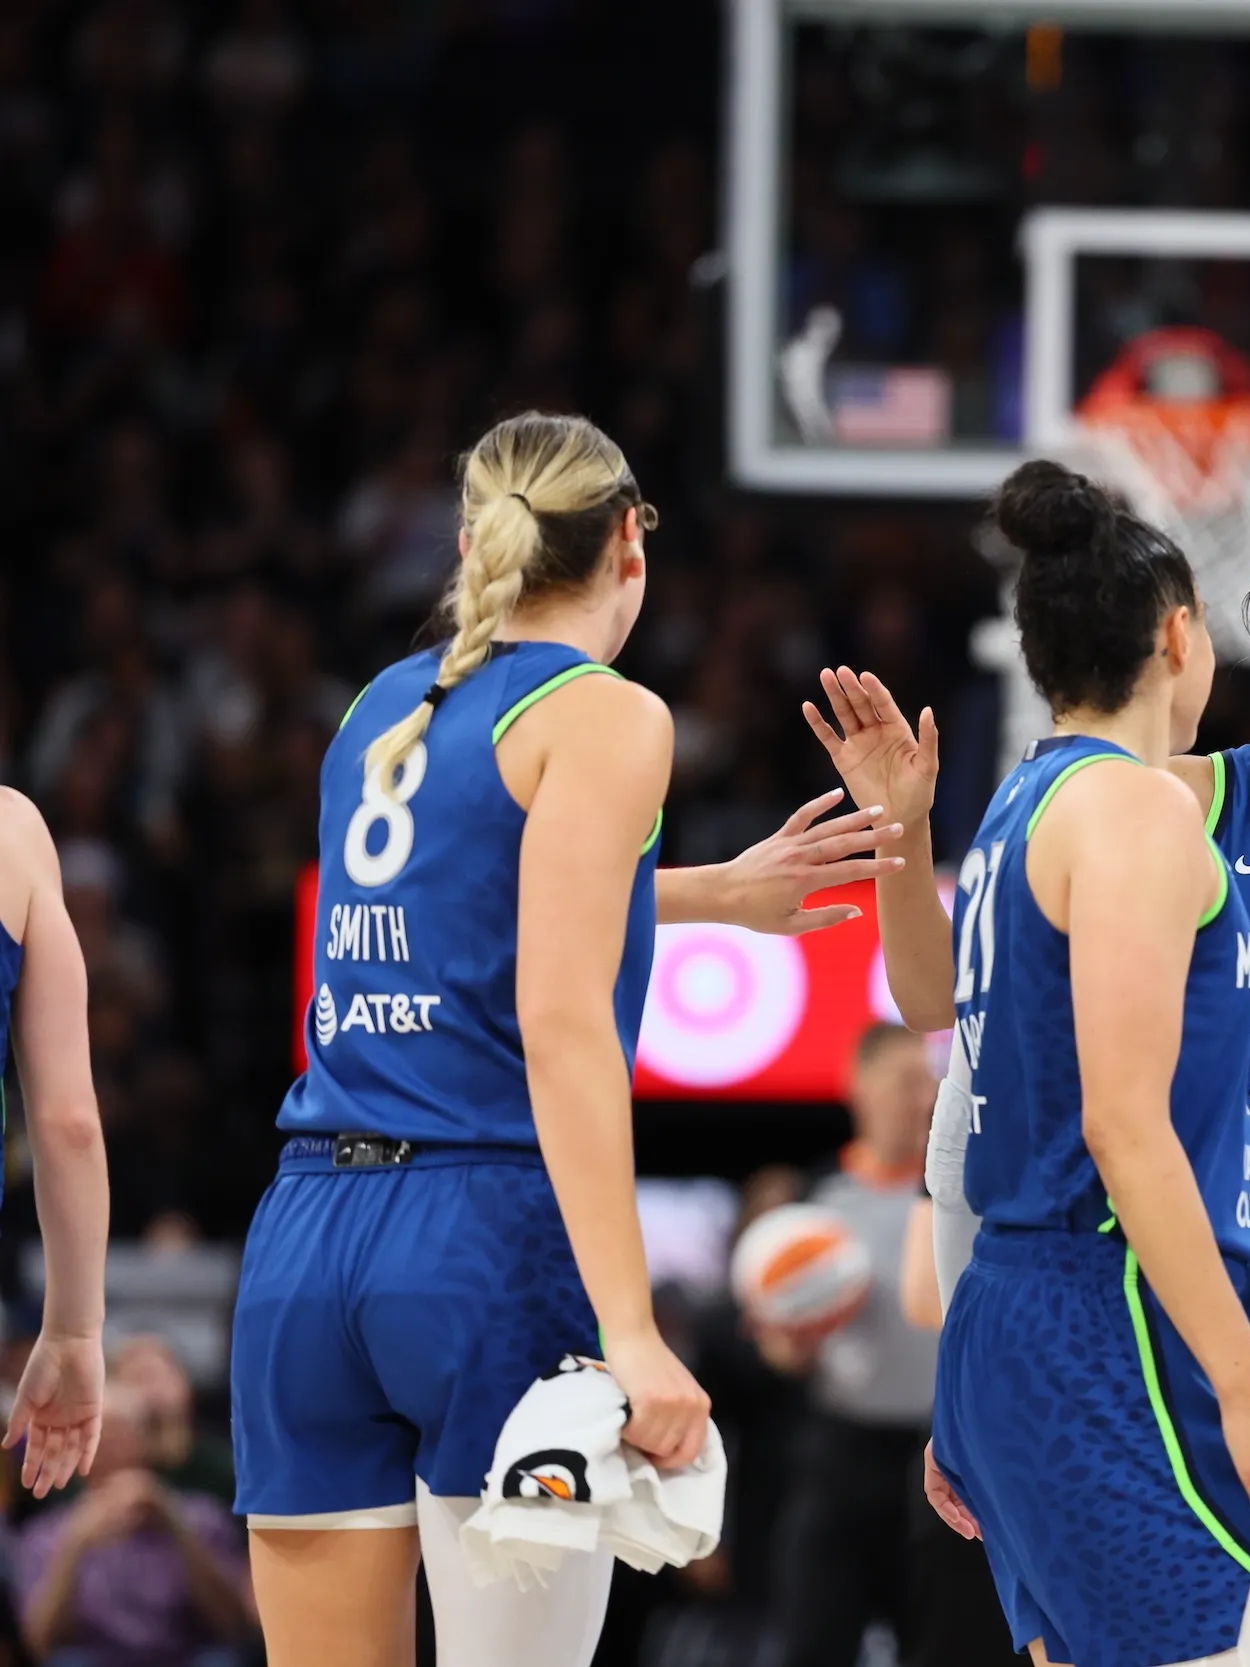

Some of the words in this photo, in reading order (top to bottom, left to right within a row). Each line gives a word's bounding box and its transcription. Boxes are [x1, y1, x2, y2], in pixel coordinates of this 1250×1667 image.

[344, 739, 428, 887] 8
[327, 904, 409, 961] SMITH
[953, 841, 1005, 1004] 21
[340, 994, 441, 1033] AT&T
